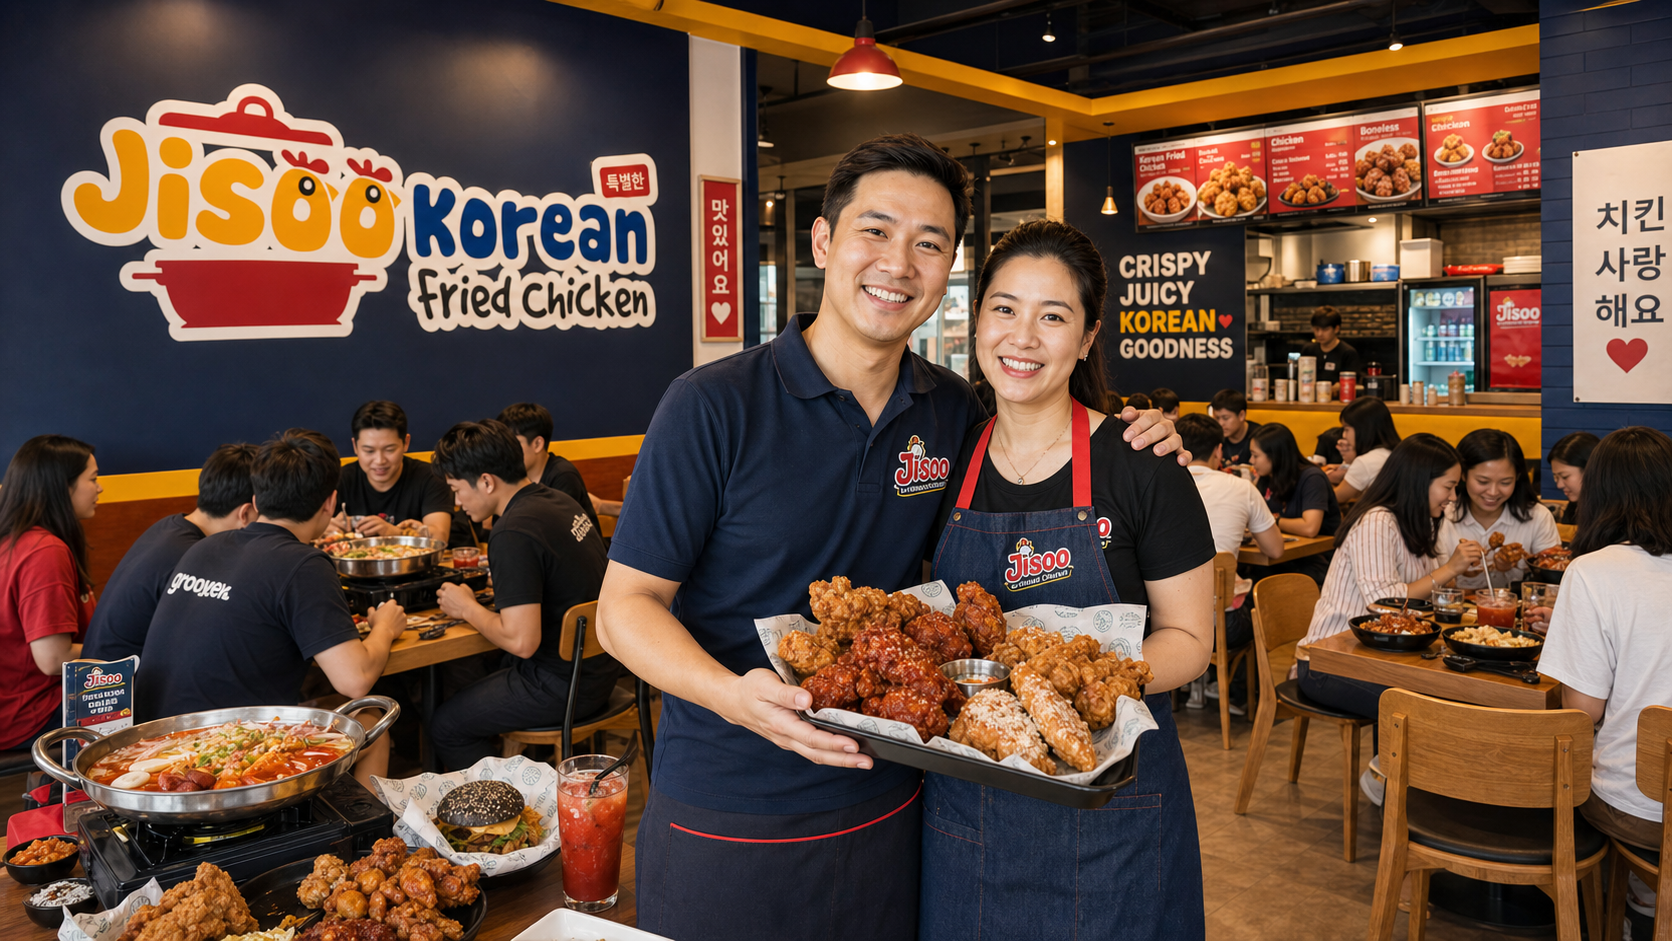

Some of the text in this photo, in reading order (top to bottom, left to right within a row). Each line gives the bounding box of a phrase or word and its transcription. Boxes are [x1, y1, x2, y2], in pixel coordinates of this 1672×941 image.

[73, 129, 402, 259] Jisoo
[606, 171, 645, 192] 특별한
[413, 184, 647, 264] Korean
[1596, 196, 1664, 235] 치킨
[711, 199, 730, 294] 맛있어요
[1595, 245, 1666, 282] 사랑
[1119, 250, 1212, 279] CRISPY
[522, 274, 648, 319] Chicken
[1119, 280, 1195, 306] JUICY
[1595, 293, 1664, 328] 해요
[1119, 309, 1216, 333] KOREAN
[1496, 304, 1541, 321] Jisoo
[1119, 337, 1234, 359] GOODNESS
[895, 451, 950, 486] Jisoo
[1005, 547, 1071, 583] Jisoo
[84, 672, 123, 689] Jisoo
